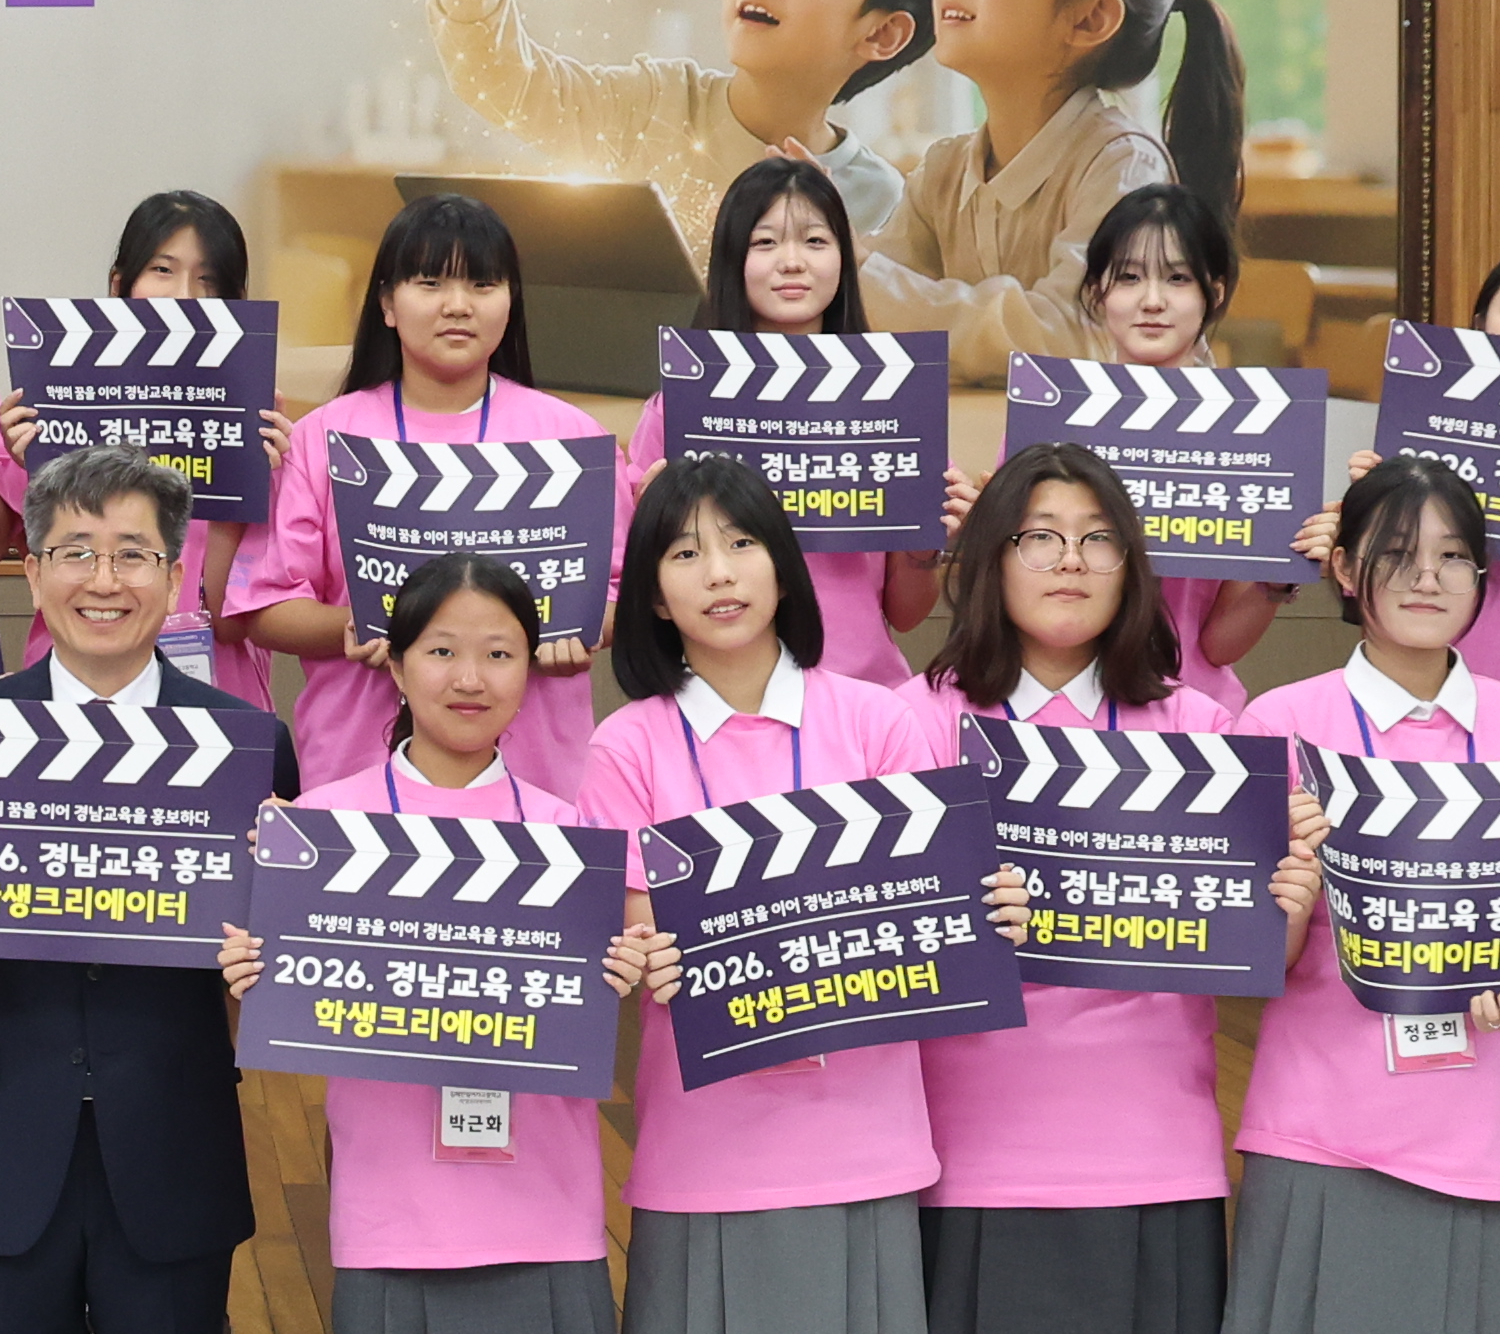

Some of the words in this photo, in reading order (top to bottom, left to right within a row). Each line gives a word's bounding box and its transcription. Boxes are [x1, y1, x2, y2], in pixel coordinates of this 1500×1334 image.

[7, 802, 37, 819] 꿈을
[41, 803, 70, 820] 이어
[74, 805, 147, 824] 경남교육을
[151, 808, 210, 827] 홍보하다
[39, 843, 163, 881] 경남교육
[171, 848, 233, 884] 홍보
[701, 912, 739, 935] 학생의
[742, 905, 768, 926] 꿈을
[771, 897, 800, 916] 이어
[803, 885, 878, 911] 경남교육을
[881, 876, 940, 899] 홍보하다
[687, 952, 773, 1000] 2026.
[779, 922, 904, 977] 경남교육
[913, 914, 976, 953] 홍보
[728, 961, 939, 1027] 학생크리에이터
[1404, 1019, 1458, 1043] 정윤희
[449, 1113, 503, 1133] 박근화
